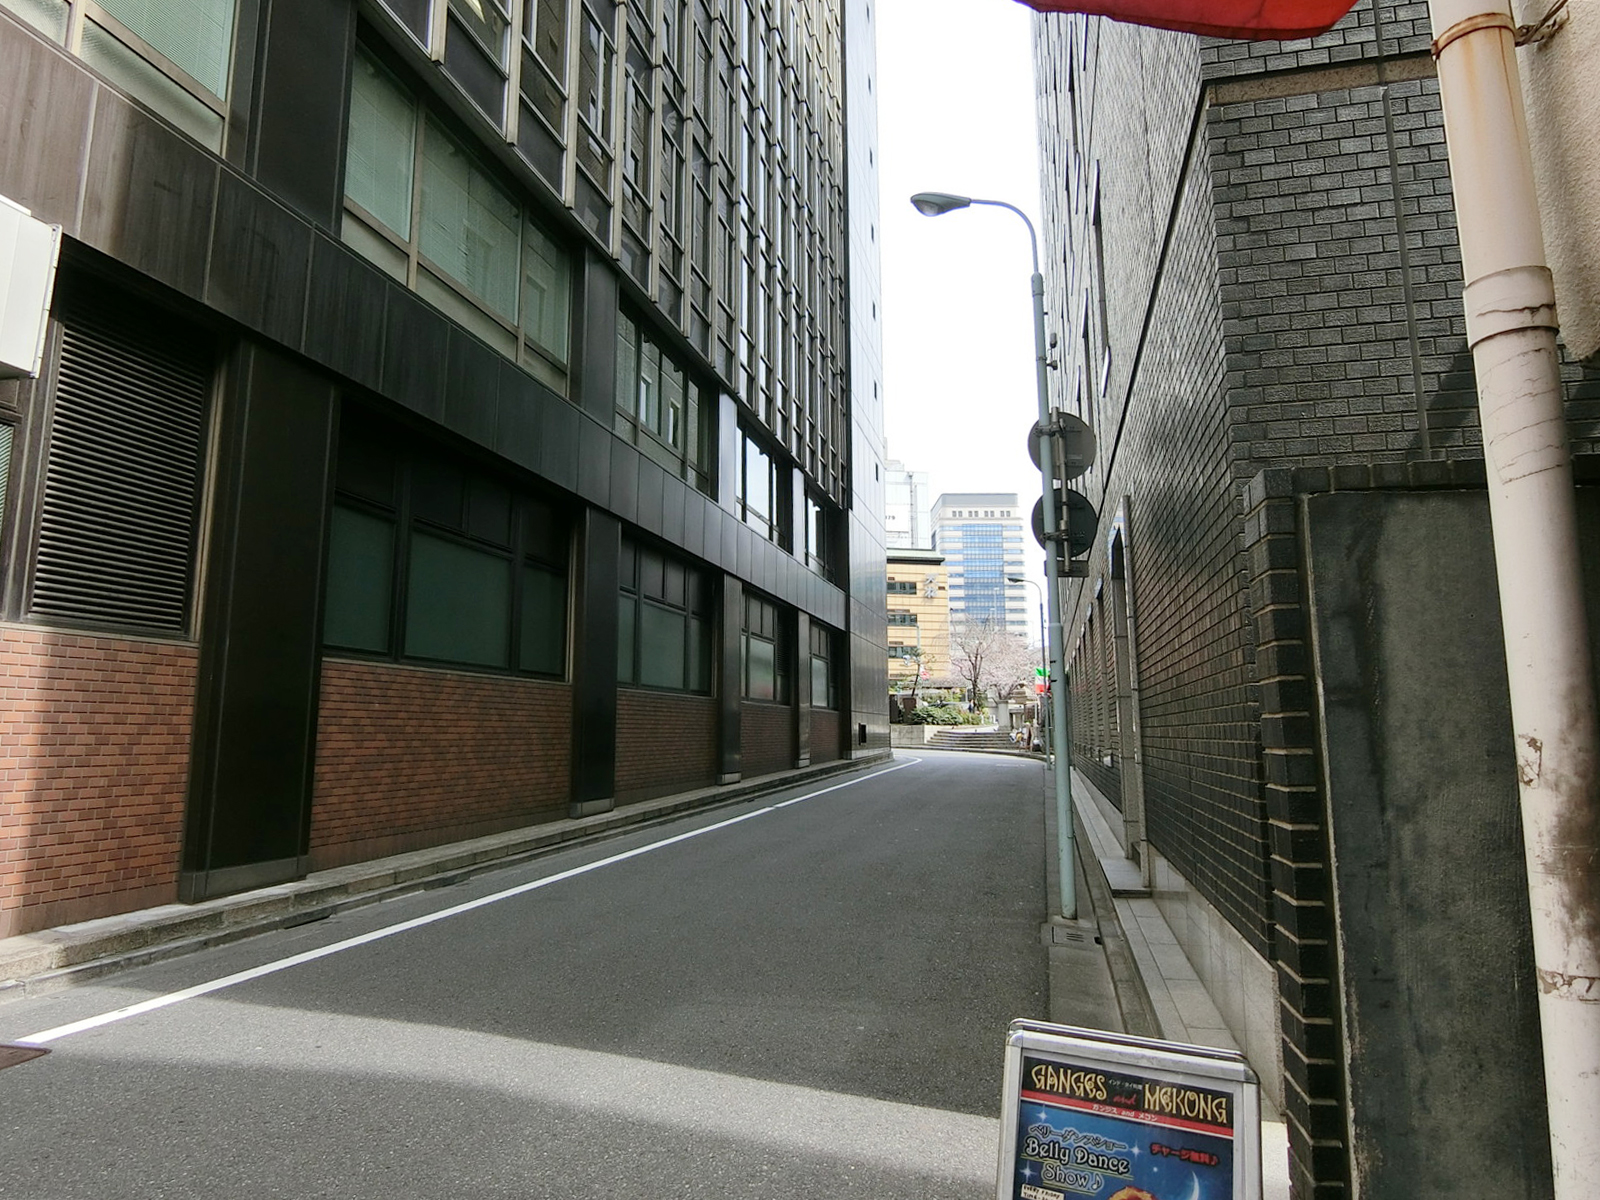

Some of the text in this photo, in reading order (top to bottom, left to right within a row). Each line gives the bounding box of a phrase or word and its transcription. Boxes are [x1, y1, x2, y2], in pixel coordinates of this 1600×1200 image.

[1031, 1064, 1107, 1101] GANGES
[1144, 1082, 1227, 1124] MEKONG
[1092, 1104, 1118, 1115] ガンジス
[1138, 1112, 1158, 1122] メコン
[1029, 1123, 1127, 1151] ベリーダンスショー
[1025, 1136, 1129, 1174] Belly Dance
[1043, 1162, 1089, 1188] Show
